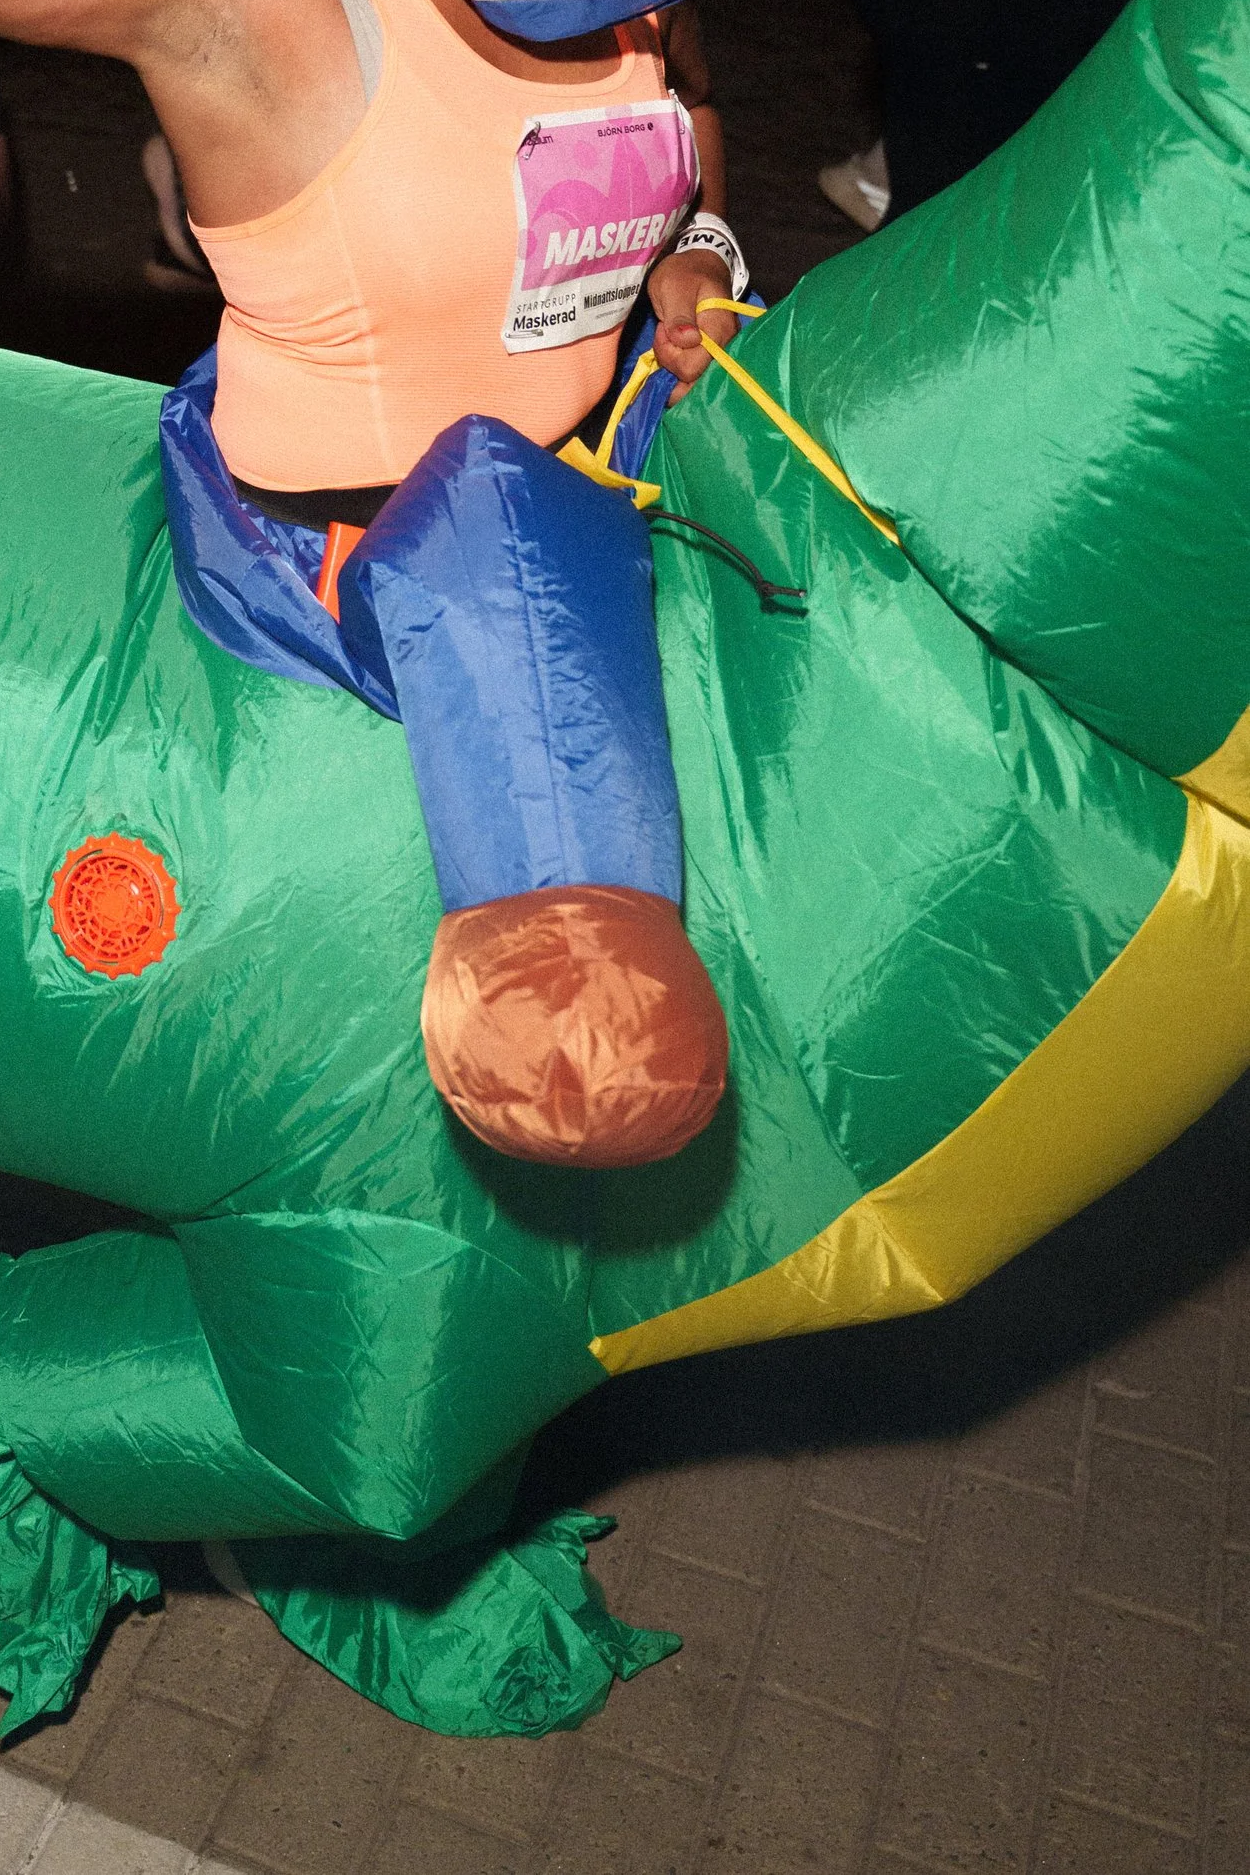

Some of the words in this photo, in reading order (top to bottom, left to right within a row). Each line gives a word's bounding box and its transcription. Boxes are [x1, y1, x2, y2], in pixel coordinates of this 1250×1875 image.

[597, 126, 623, 138] BJÖRN
[625, 123, 646, 134] BORG
[516, 293, 577, 315] STARTGRUPP
[513, 306, 577, 332] Maskerad
